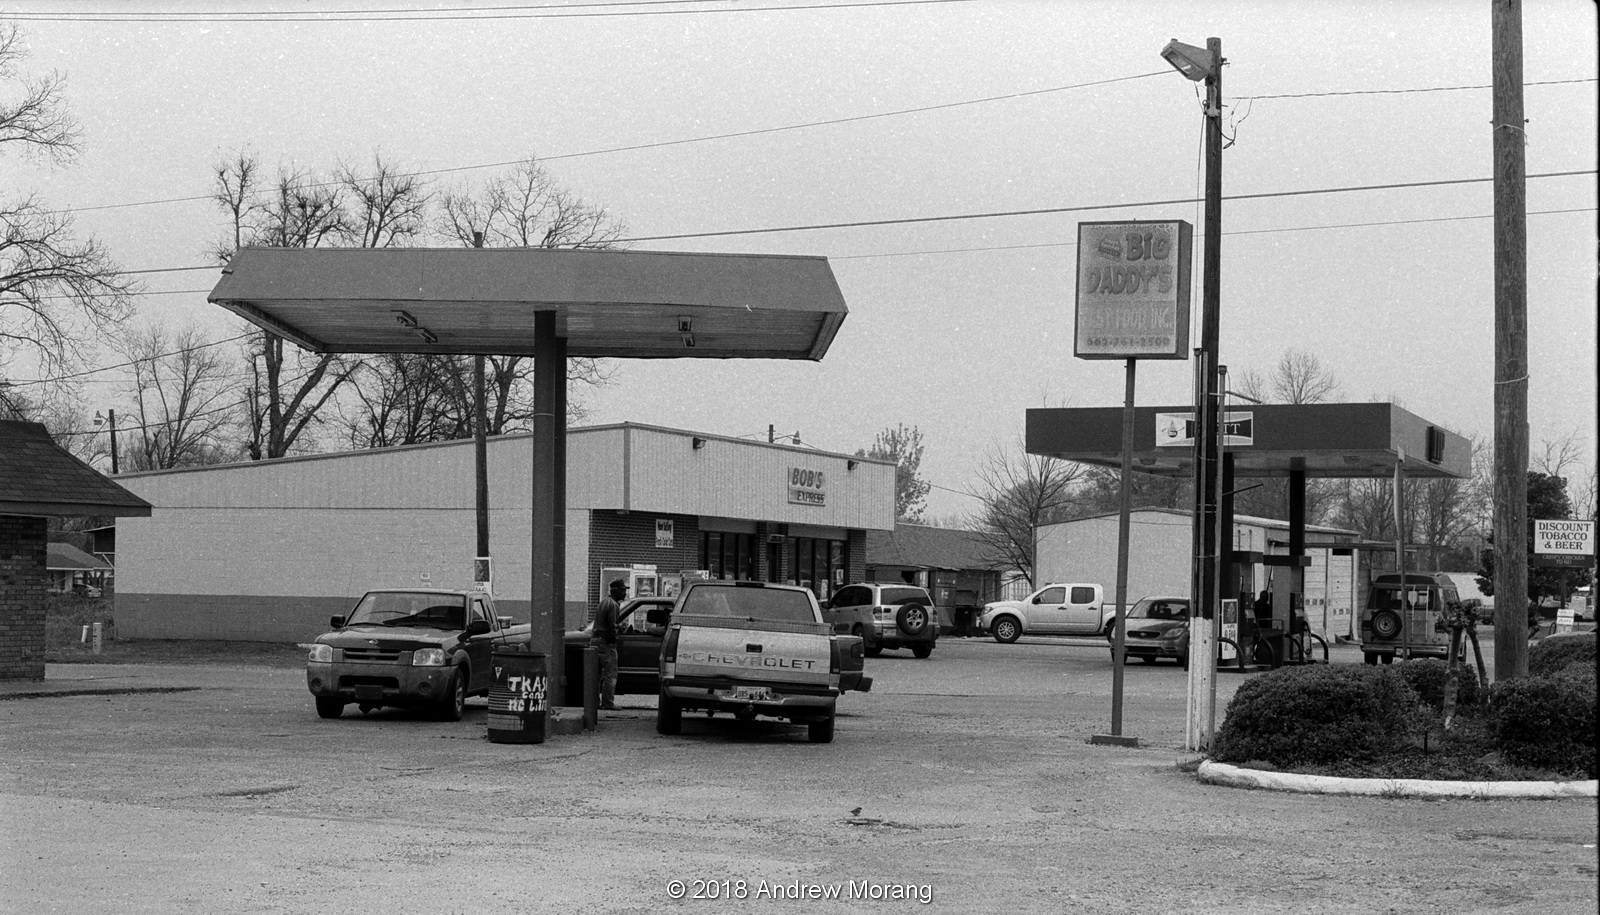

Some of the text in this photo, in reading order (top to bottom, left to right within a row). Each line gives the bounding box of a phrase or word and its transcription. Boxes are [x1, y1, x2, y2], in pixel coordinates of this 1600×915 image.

[1086, 265, 1173, 295] DADDY'S
[791, 468, 823, 489] BOB'S
[797, 491, 825, 504] EXPRESS
[1538, 522, 1591, 532] DISCOUNT
[1539, 531, 1588, 541] TOBACCO
[1544, 541, 1583, 550] & BEER
[692, 652, 816, 670] CHEVROLET
